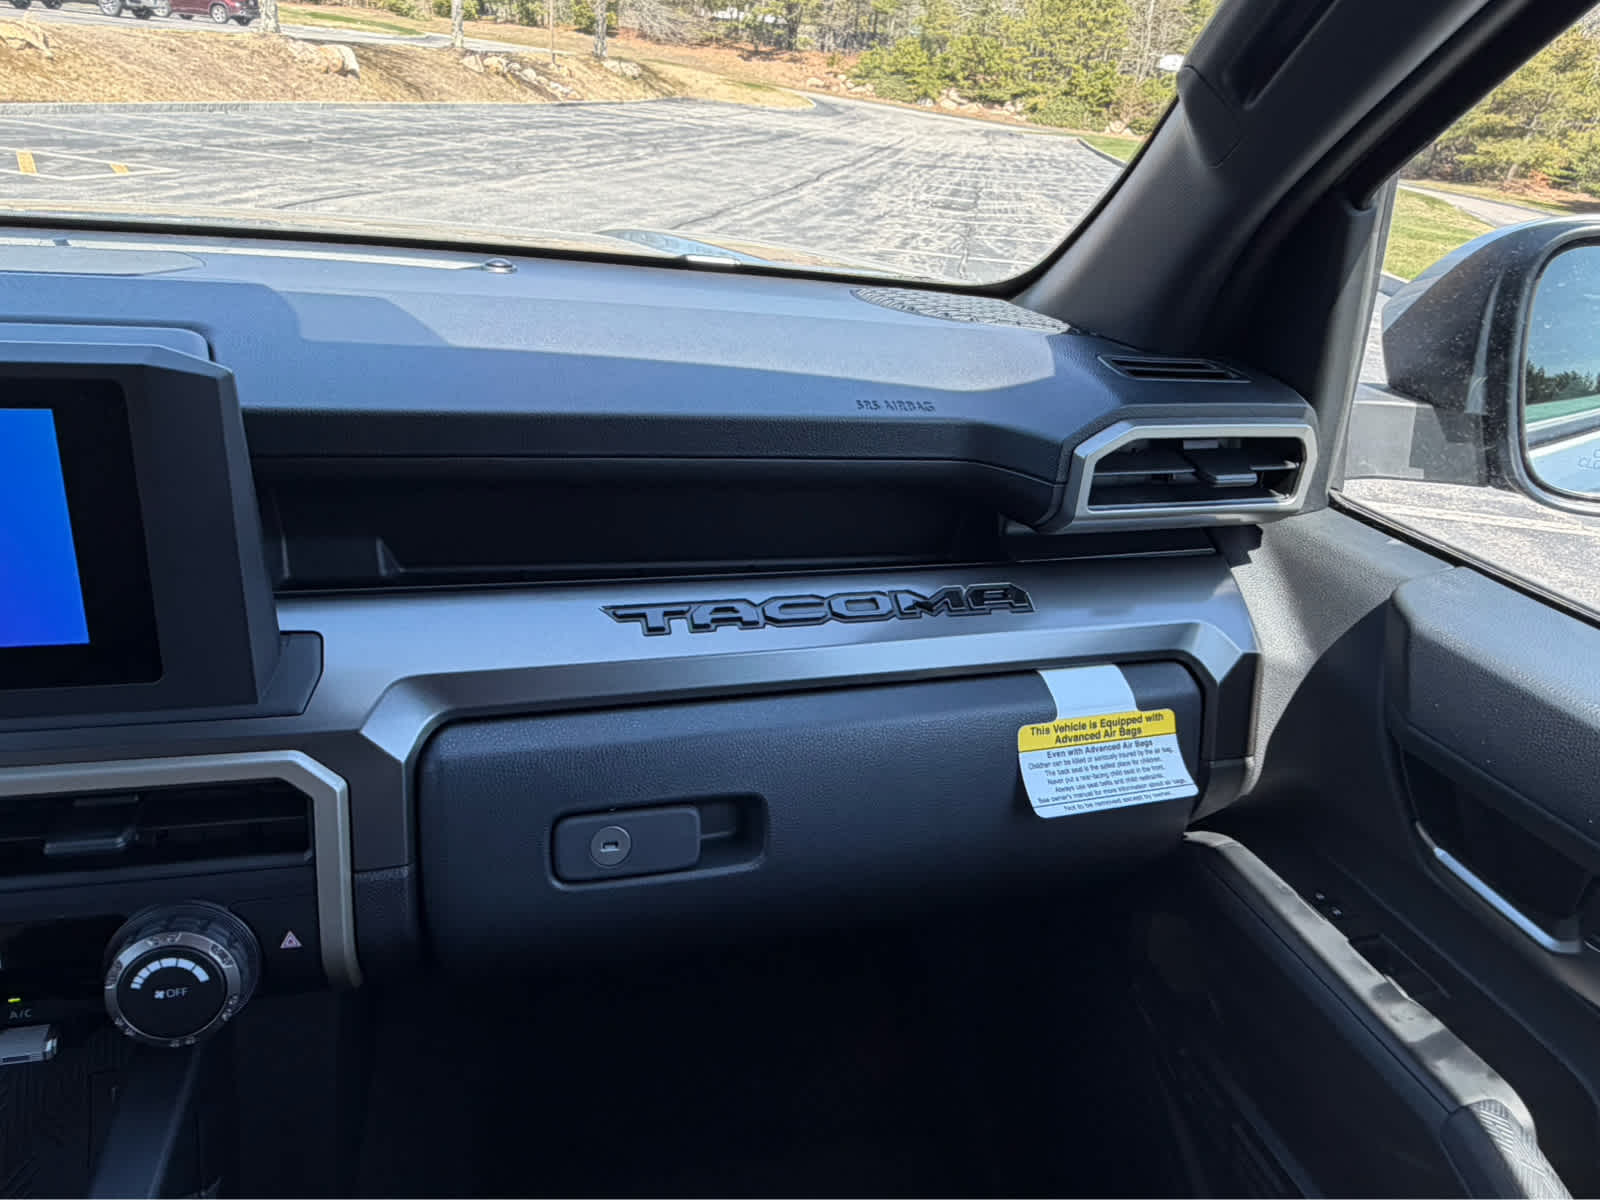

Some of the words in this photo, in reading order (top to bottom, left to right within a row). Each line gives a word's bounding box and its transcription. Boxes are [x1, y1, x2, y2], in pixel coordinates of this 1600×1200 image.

[856, 399, 880, 410] SRS
[884, 399, 935, 412] AIRBAG
[600, 583, 1036, 636] TACOMA
[1030, 726, 1050, 736] This
[1053, 721, 1087, 733] Vehicle
[1100, 715, 1143, 730] Equipped
[1145, 712, 1164, 722] with
[1055, 730, 1101, 744] Advanced
[1104, 728, 1117, 738] Air
[1119, 726, 1143, 739] Bags
[1047, 750, 1066, 759] Even
[1068, 746, 1083, 756] with
[1085, 743, 1121, 754] Advanced
[1123, 740, 1133, 749] Air
[1135, 739, 1153, 748] Bags
[165, 987, 189, 998] OFF
[9, 1008, 32, 1019] A/C
